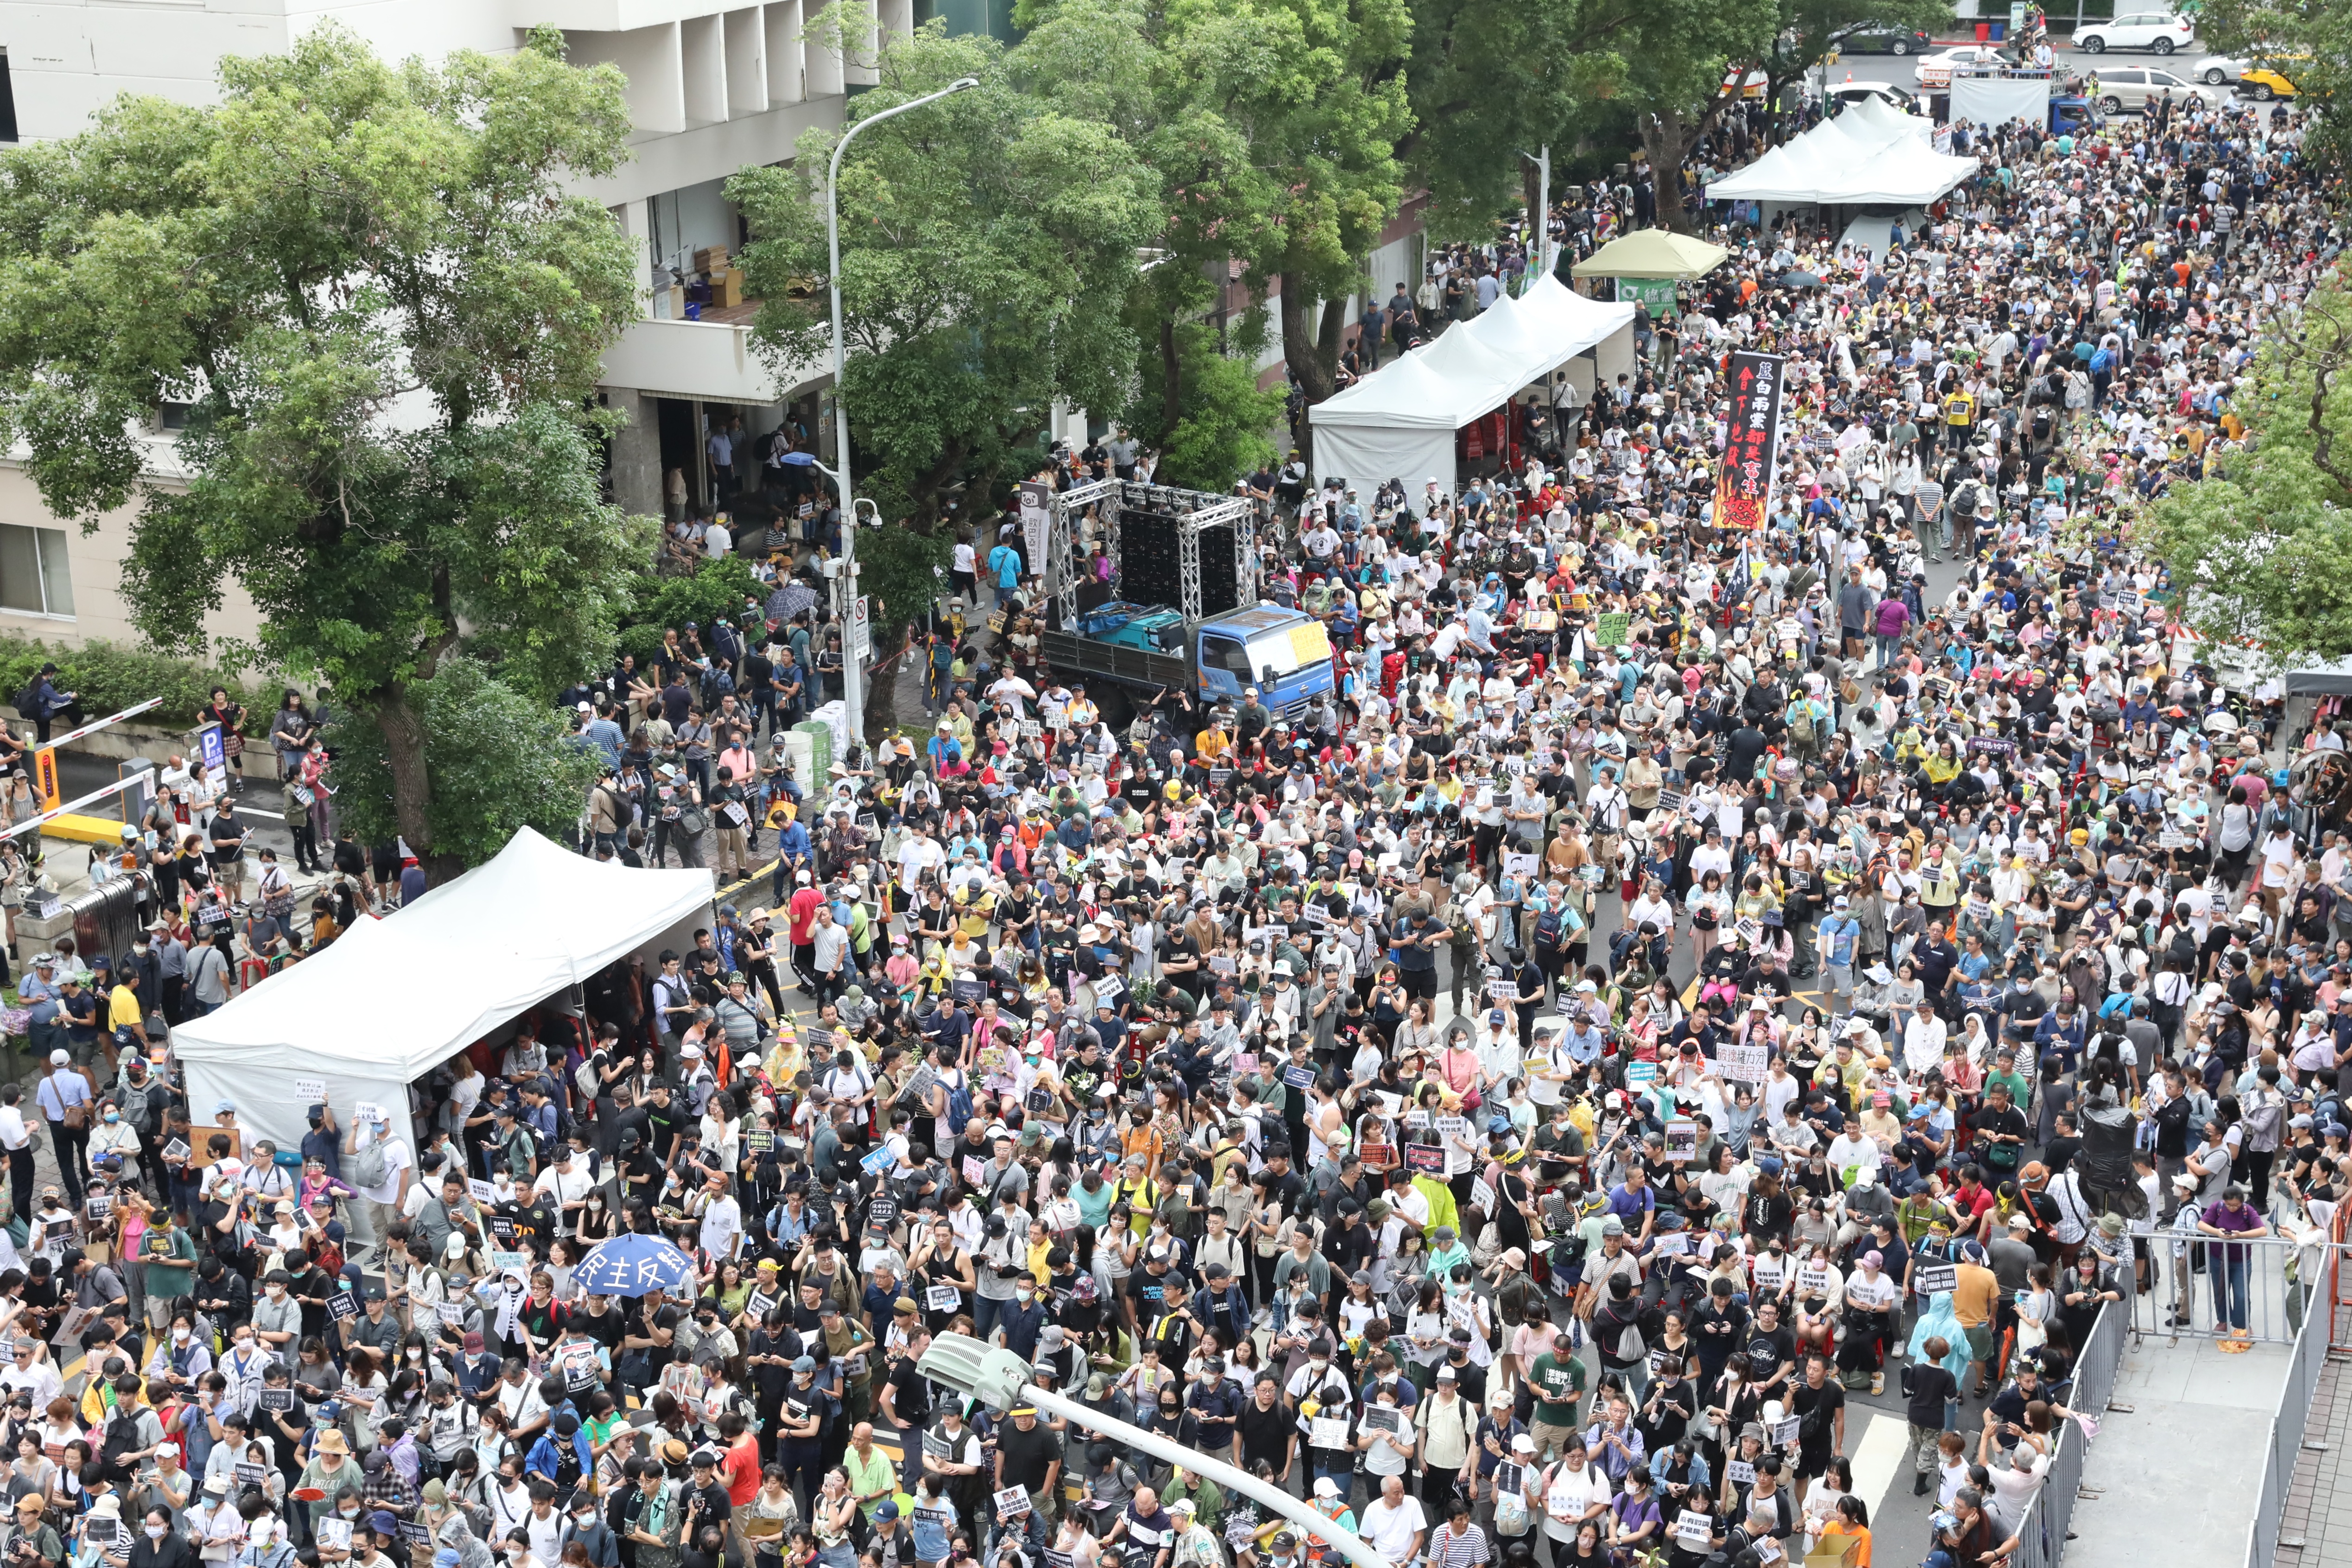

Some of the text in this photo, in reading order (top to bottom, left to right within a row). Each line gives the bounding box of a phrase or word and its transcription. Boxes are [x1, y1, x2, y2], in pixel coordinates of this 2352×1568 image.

[1644, 288, 1673, 303] 綠黨
[1723, 496, 1757, 526] 怒
[1599, 615, 1627, 628] 台中
[1597, 629, 1627, 646] 公民
[204, 733, 217, 758] P
[212, 747, 222, 757] 台大
[1717, 1047, 1766, 1065] 破壞權力分
[1718, 1066, 1767, 1082] 立不是民主
[1749, 1350, 1775, 1361] AHSOKA
[1730, 1472, 1753, 1481] 不是民
